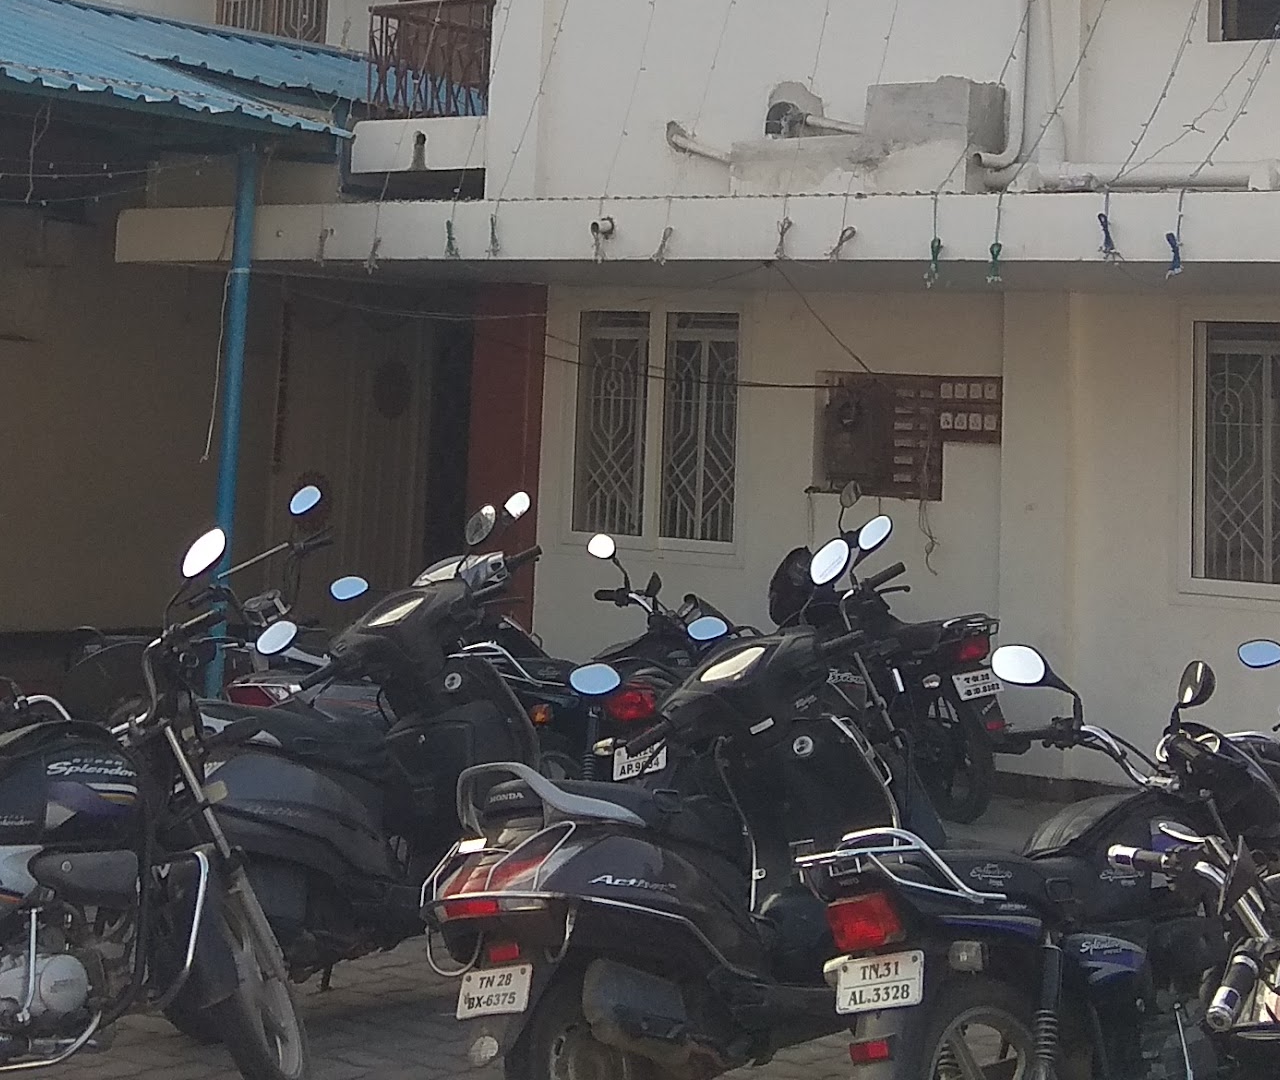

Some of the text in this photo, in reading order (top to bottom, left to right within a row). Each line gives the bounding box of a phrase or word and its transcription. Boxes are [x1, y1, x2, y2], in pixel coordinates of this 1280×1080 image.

[46, 761, 137, 776] Splendor
[489, 792, 524, 803] HONDA
[860, 961, 900, 980] TN.31
[480, 973, 513, 989] TN 28
[848, 984, 911, 1006] AL.3328
